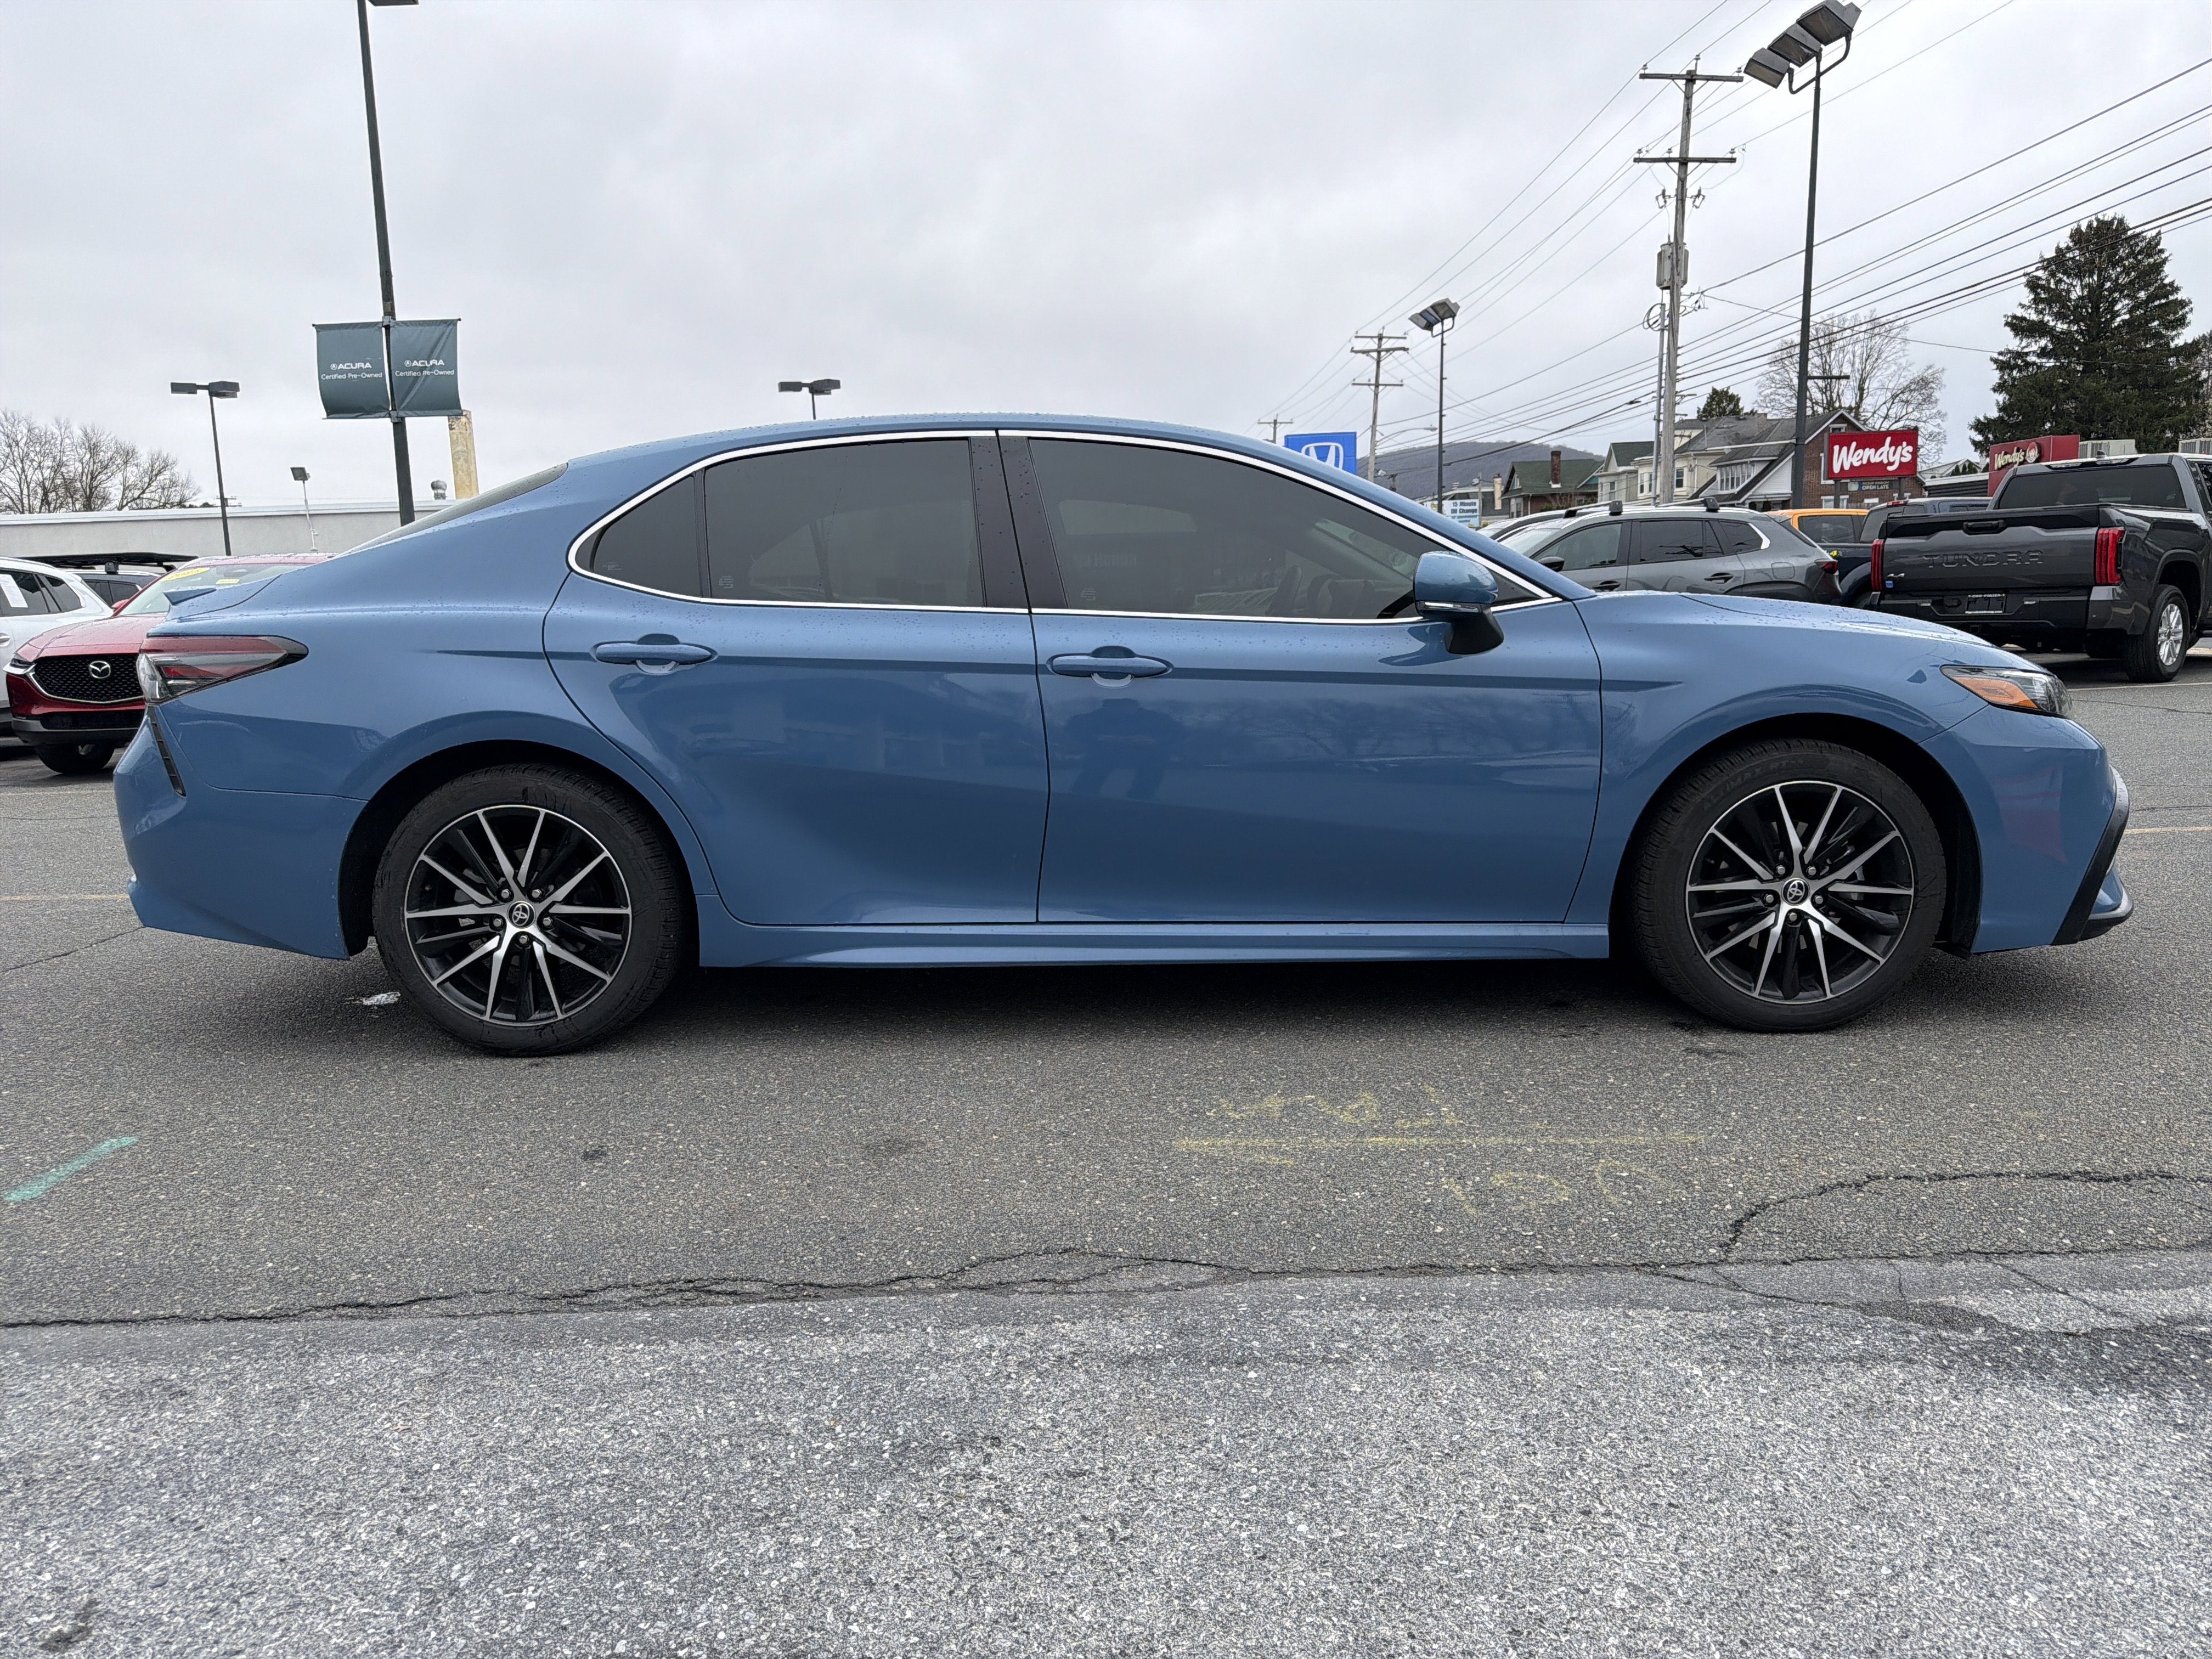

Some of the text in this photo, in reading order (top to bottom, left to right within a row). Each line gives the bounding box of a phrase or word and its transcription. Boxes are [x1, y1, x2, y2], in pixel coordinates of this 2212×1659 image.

[412, 359, 445, 367] ACURA
[1833, 436, 1913, 473] Wendy's
[1994, 446, 2025, 470] Wendy's
[1922, 550, 2044, 568] TUNDRA
